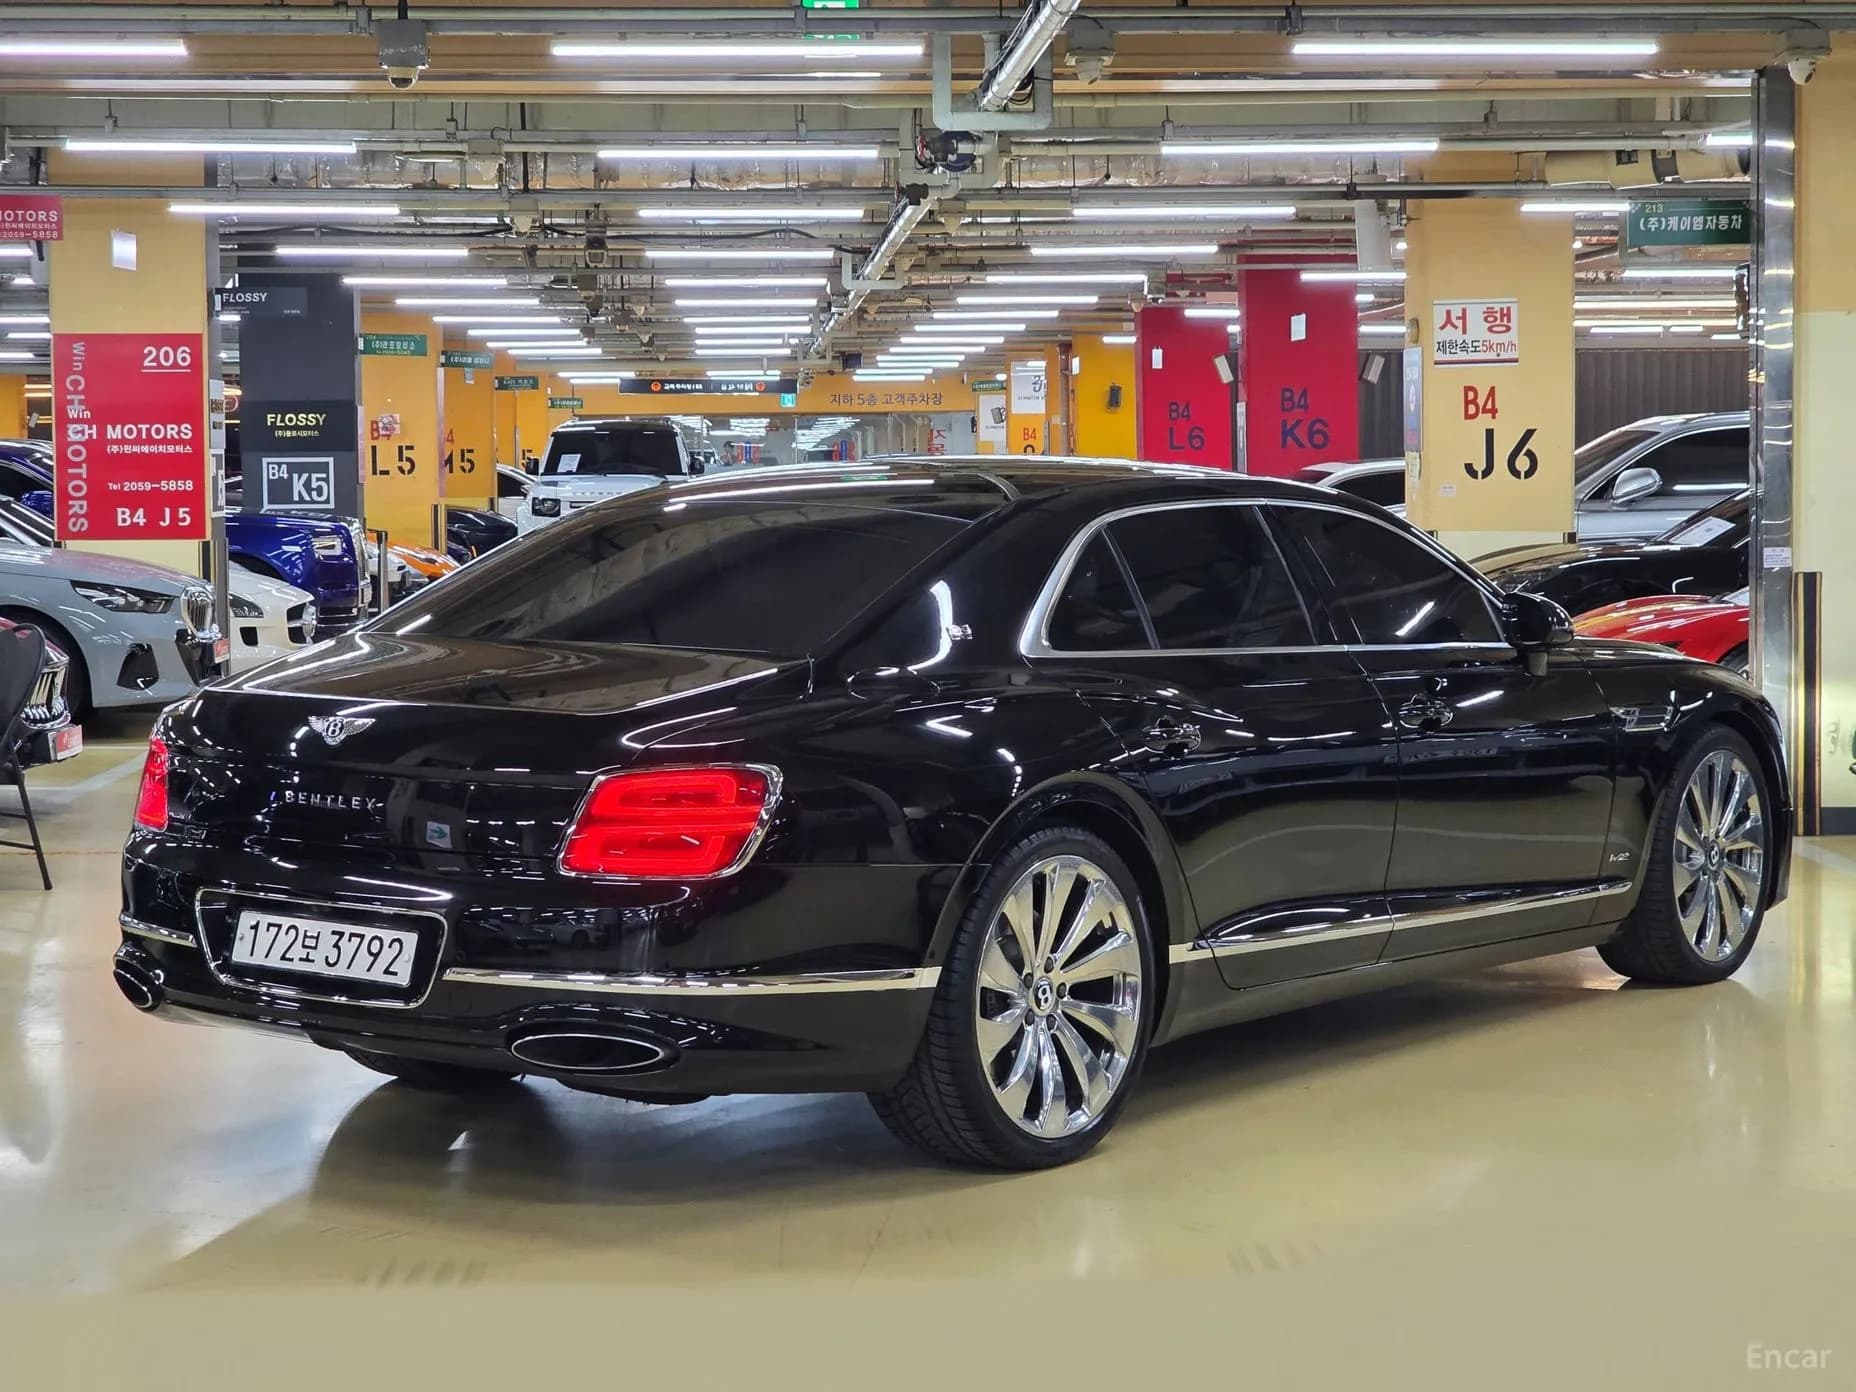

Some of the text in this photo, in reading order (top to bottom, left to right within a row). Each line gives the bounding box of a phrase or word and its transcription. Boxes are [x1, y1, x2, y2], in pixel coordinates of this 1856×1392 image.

[0, 210, 58, 222] OTORS
[1645, 203, 1664, 213] 213
[1639, 214, 1743, 232] (주)케이엠자동차
[222, 292, 268, 302] FLOSSY
[143, 346, 191, 367] 206
[831, 393, 854, 406] 지하
[1280, 387, 1309, 413] B4
[1463, 385, 1498, 421] B4
[67, 409, 92, 419] Win
[266, 413, 327, 426] FLOSSY
[1168, 401, 1191, 421] B4
[106, 424, 193, 440] MOTORS
[1023, 427, 1037, 441] B4
[1168, 426, 1205, 450] L6
[1280, 418, 1329, 450] K6
[371, 445, 416, 476] L5
[1464, 428, 1538, 480] J6
[268, 463, 289, 480] B4
[108, 480, 194, 491] Tel 2059-5858
[292, 473, 329, 502] K5
[116, 507, 147, 527] B4
[285, 790, 377, 812] BENTLEY
